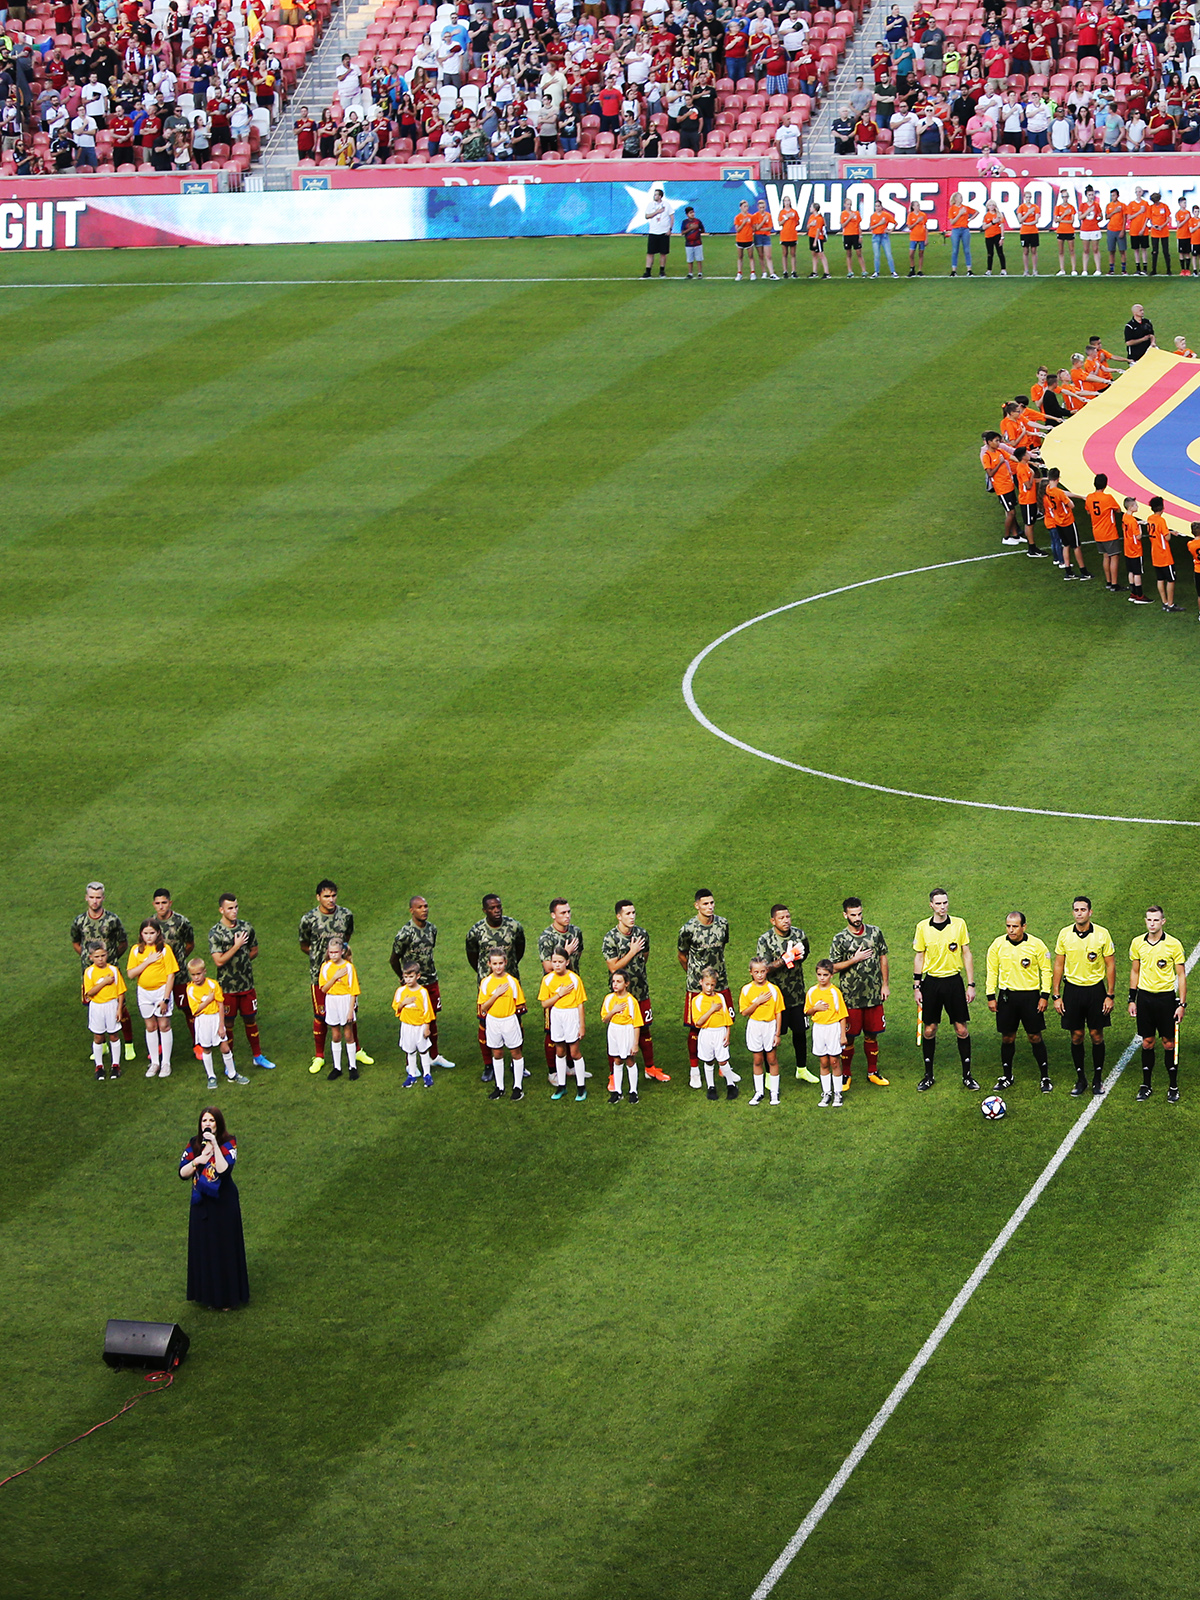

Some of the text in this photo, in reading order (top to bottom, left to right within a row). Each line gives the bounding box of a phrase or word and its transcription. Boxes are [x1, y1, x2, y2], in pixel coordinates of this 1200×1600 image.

[765, 182, 939, 231] WHOSE
[1093, 501, 1101, 516] 5
[178, 994, 185, 1006] 7
[729, 1006, 736, 1019] 8
